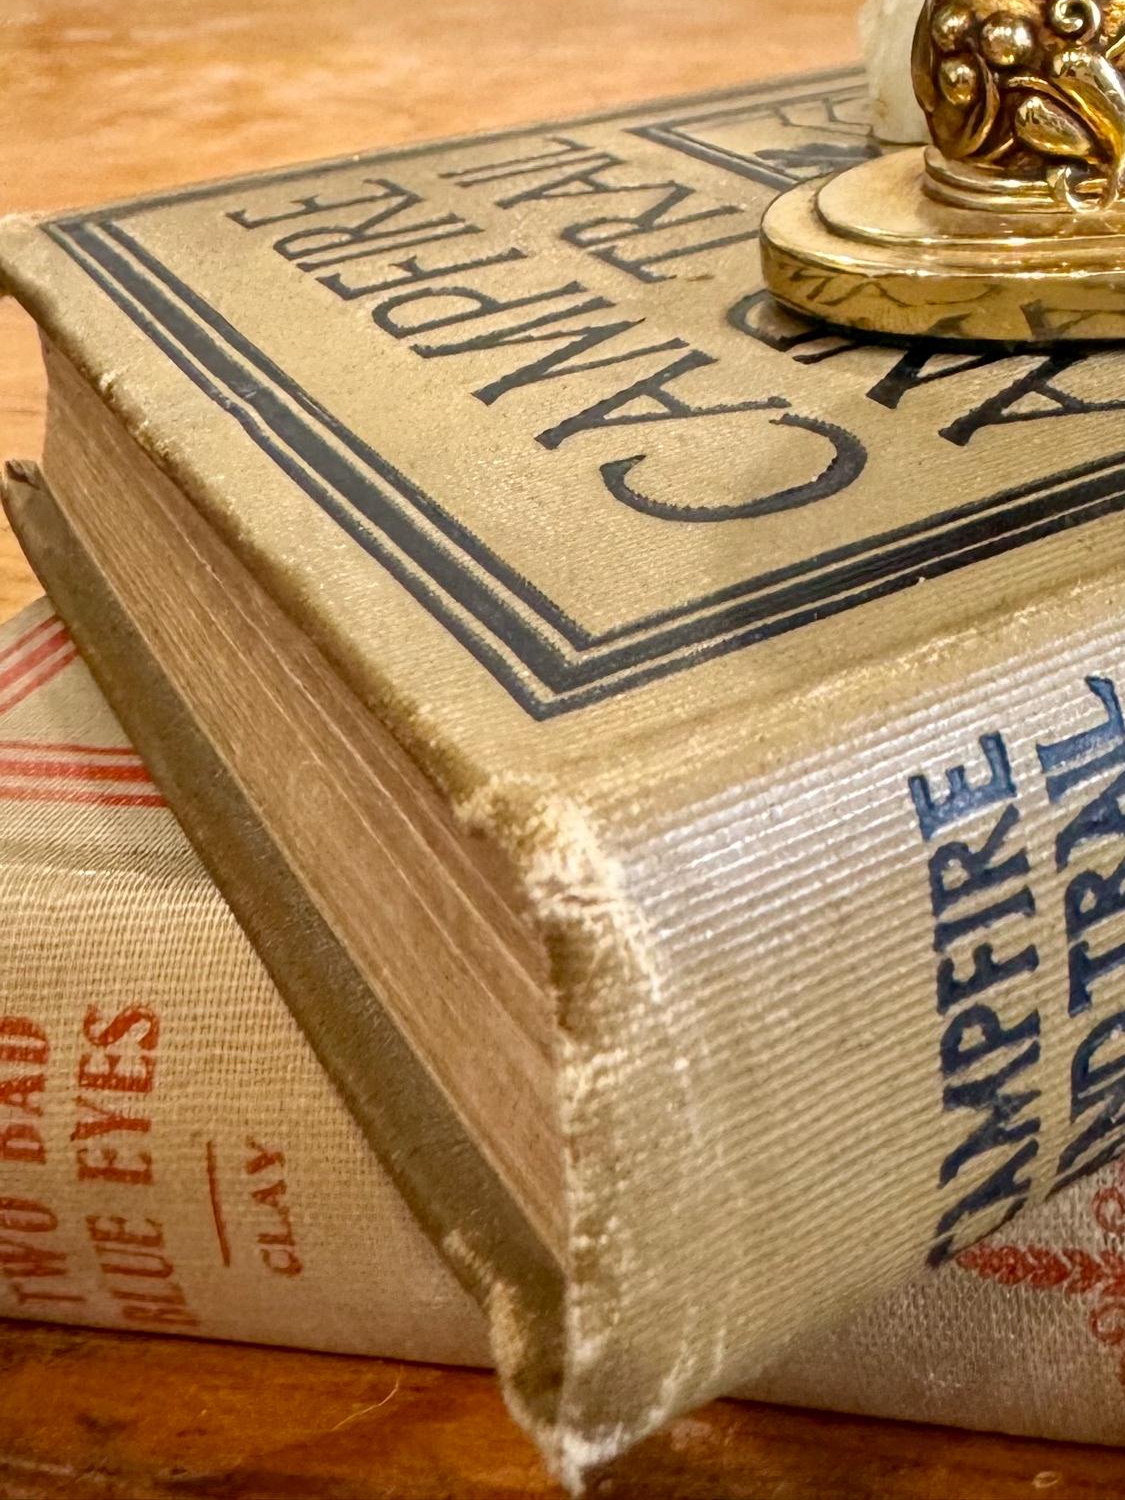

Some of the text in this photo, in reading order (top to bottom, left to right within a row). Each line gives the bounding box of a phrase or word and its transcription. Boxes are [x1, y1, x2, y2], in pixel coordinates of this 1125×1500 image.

[438, 136, 760, 284] TRAIL
[225, 176, 868, 523] CAMPFIRE
[70, 1003, 160, 1185] EYES
[246, 1135, 303, 1277] CLAY
